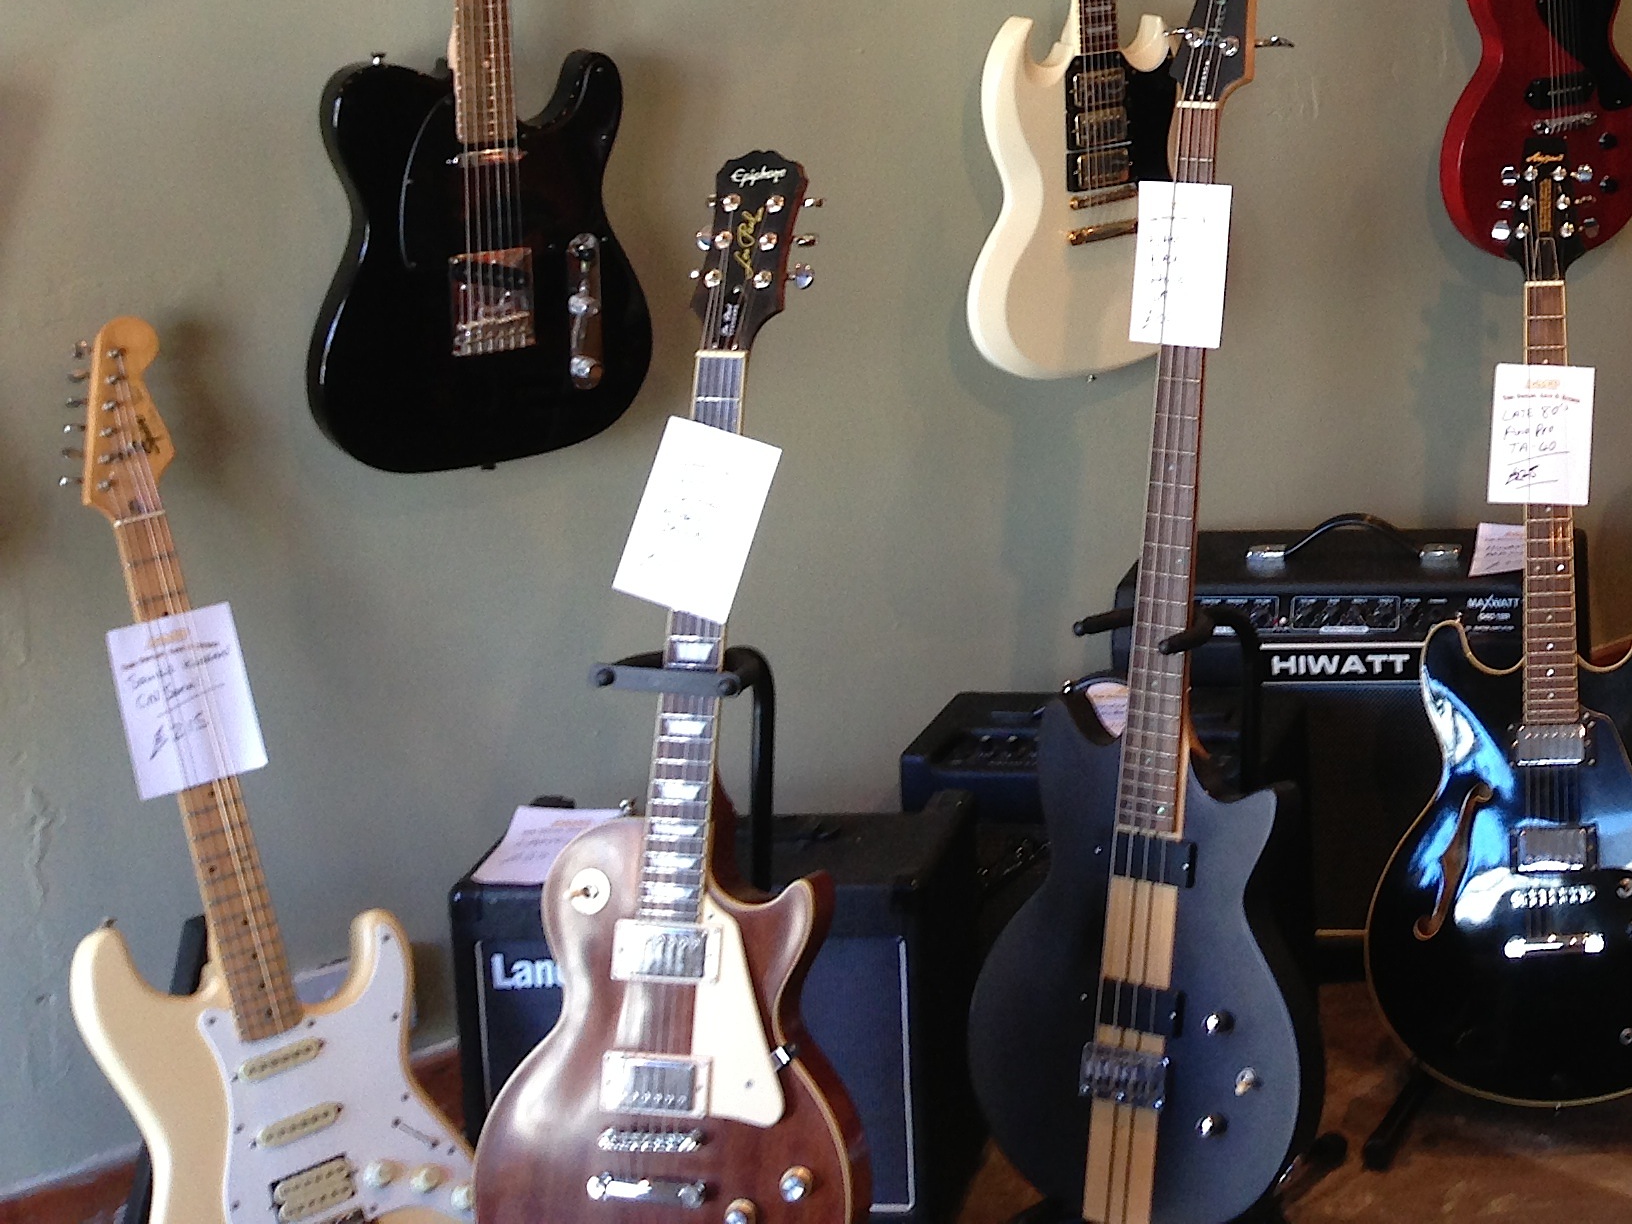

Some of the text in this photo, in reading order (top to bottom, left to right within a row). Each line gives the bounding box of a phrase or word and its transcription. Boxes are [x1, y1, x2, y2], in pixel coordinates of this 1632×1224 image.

[730, 164, 788, 189] Epiphone
[1466, 594, 1521, 613] MAXWATT
[1270, 653, 1411, 677] HIWATT
[490, 951, 565, 992] Lan
